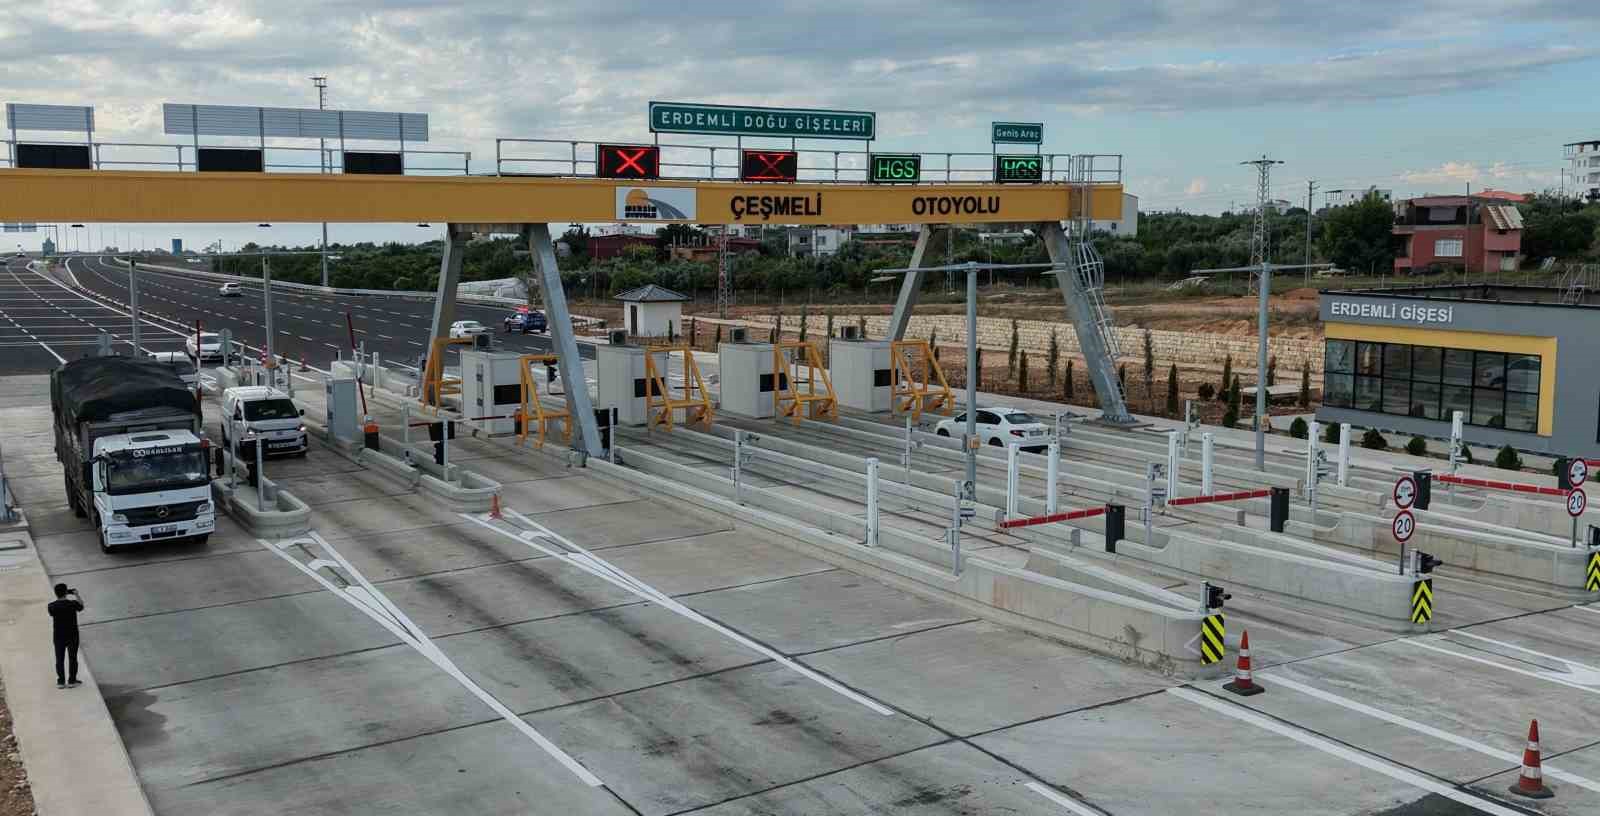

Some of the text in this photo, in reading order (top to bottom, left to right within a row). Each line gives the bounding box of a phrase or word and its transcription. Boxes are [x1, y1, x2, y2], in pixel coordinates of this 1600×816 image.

[661, 111, 867, 133] ERDEMLİ DOĞU GİŞELERİ
[878, 160, 915, 178] HGS
[1004, 160, 1038, 178] HGS
[730, 192, 1000, 220] ÇEŞMELİ OTOYOLU
[1331, 302, 1453, 324] ERDEMLİ GİŞESİ
[1570, 495, 1582, 510] 20
[1397, 518, 1411, 534] 20
